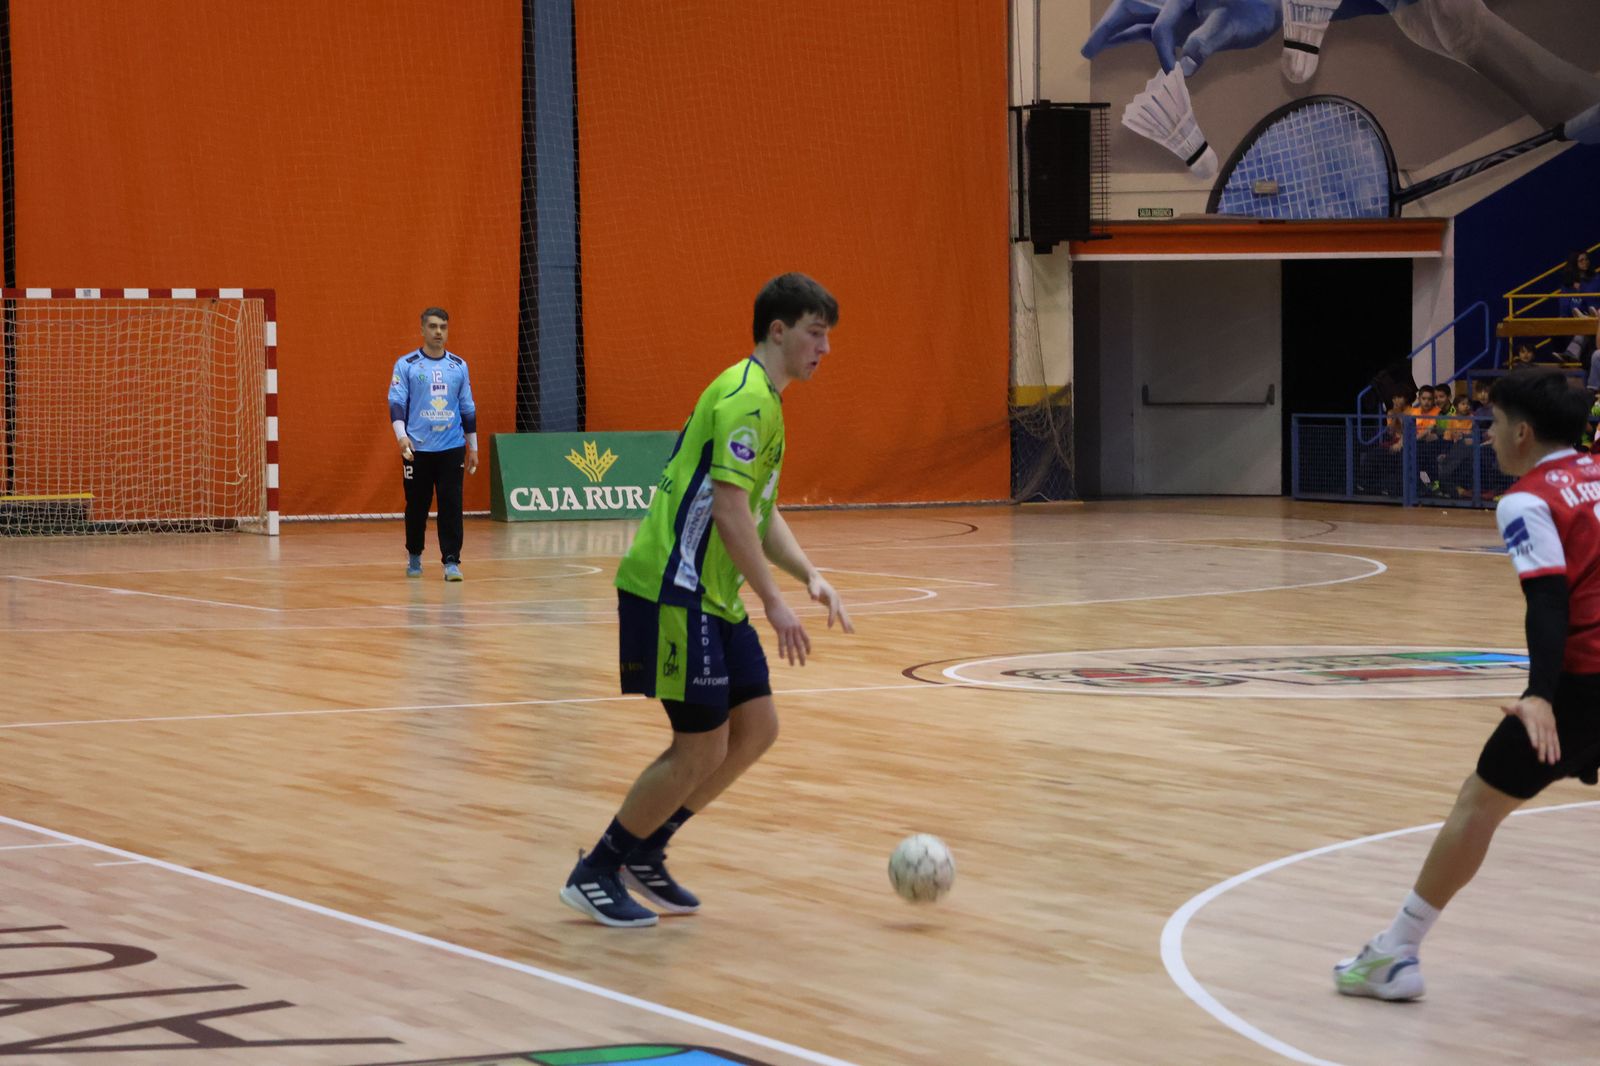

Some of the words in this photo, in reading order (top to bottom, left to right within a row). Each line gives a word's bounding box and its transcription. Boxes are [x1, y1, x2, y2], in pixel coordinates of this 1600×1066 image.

[432, 370, 443, 383] 12
[403, 464, 413, 480] 12
[509, 486, 584, 513] CAJA
